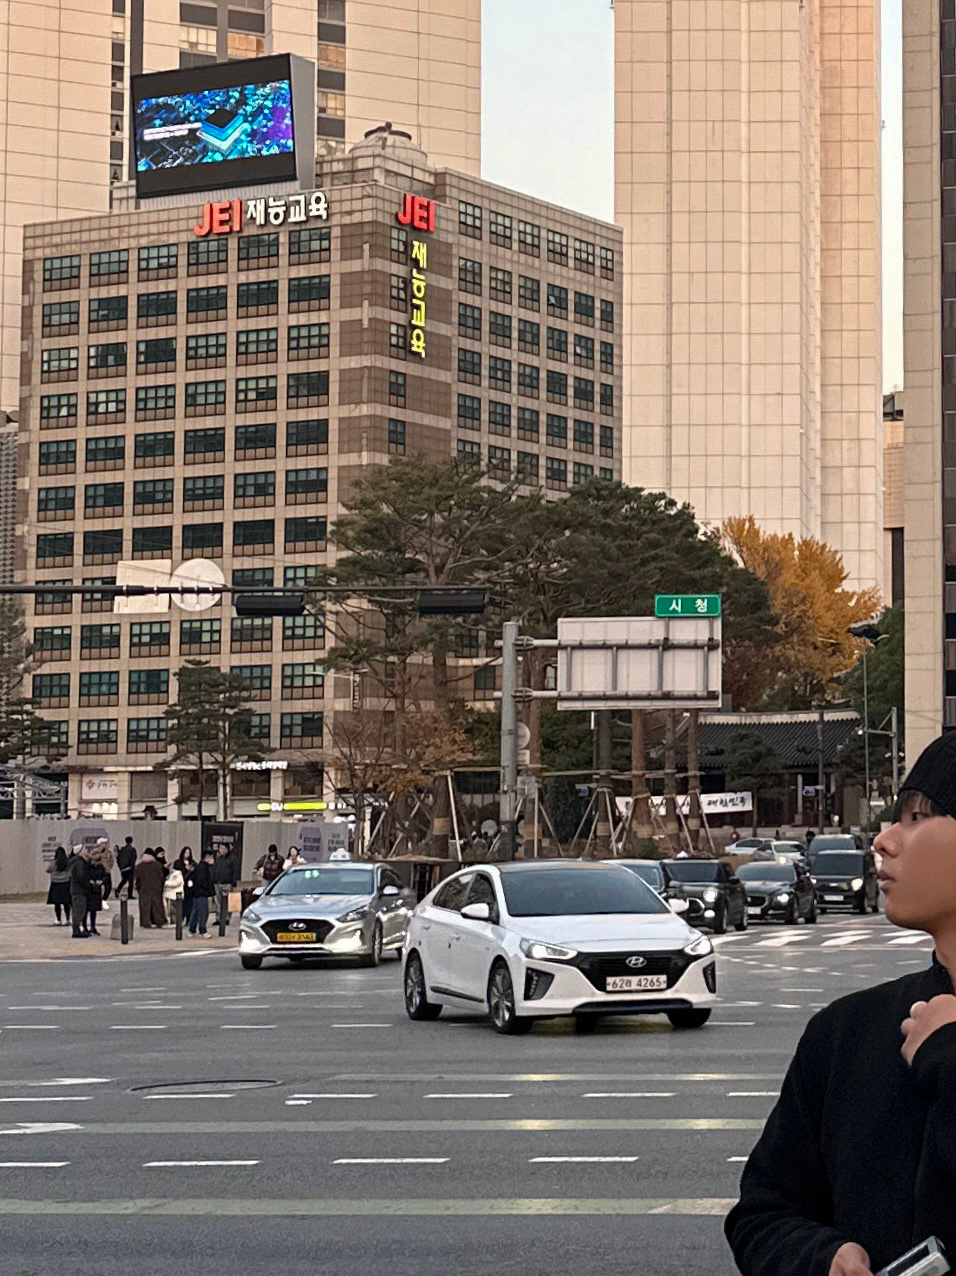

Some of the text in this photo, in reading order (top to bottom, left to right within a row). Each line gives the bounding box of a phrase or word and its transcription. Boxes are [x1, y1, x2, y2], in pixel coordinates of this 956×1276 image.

[193, 198, 242, 236] JEI
[247, 191, 328, 226] 재능교육
[397, 193, 436, 232] JEI
[411, 240, 427, 359] 재능교육
[668, 598, 708, 613] 시청
[636, 977, 662, 988] 4265
